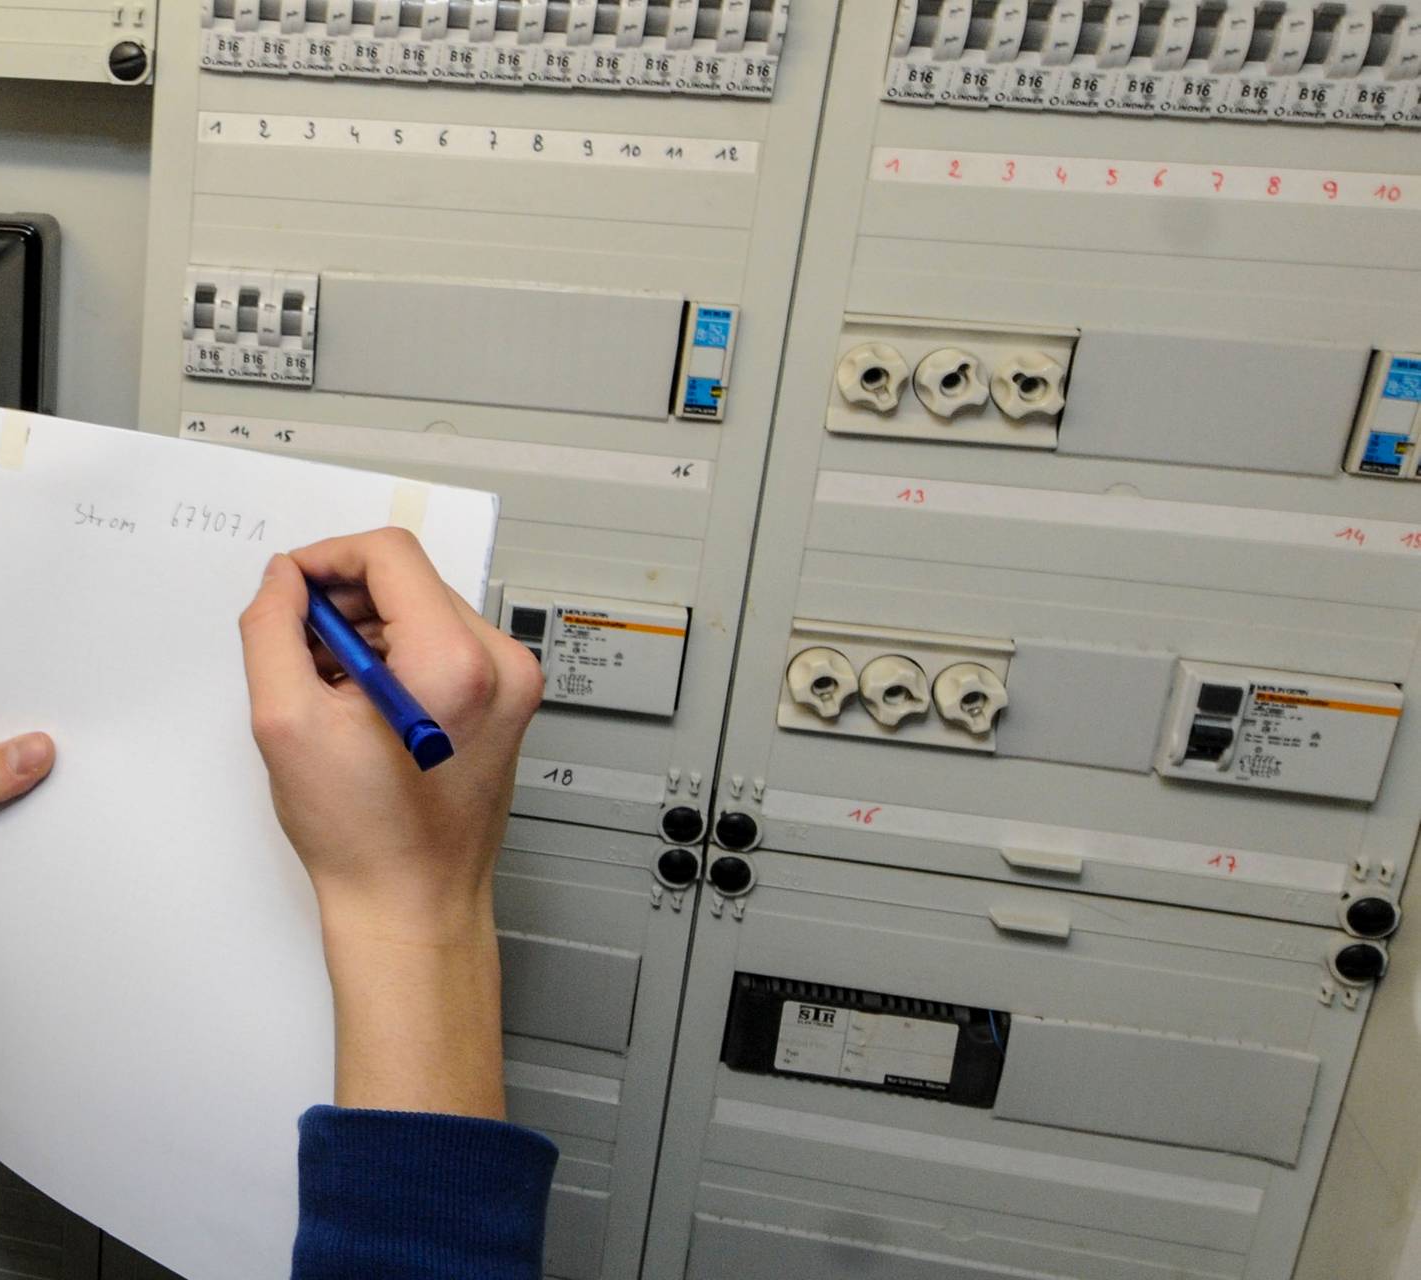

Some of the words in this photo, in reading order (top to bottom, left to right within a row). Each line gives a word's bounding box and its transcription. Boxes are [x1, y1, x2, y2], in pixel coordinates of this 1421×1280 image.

[209, 120, 222, 134] 1
[258, 120, 271, 138] 2
[304, 121, 316, 139] 3
[350, 125, 360, 143] 4
[394, 129, 403, 144] 5
[438, 130, 449, 147] 6
[489, 130, 498, 150] 7
[533, 134, 544, 152] 8
[583, 139, 594, 156] 9
[620, 144, 641, 157] 10
[666, 144, 683, 158] 11
[714, 147, 738, 161] 12
[885, 159, 899, 173] 1
[948, 159, 962, 178] 2
[1002, 160, 1015, 181] 3
[1056, 166, 1067, 184] 4
[1106, 168, 1118, 186] 5
[1153, 169, 1168, 187] 6
[1212, 171, 1223, 192] 7
[1267, 176, 1281, 195] 8
[1323, 180, 1338, 199] 9
[1374, 185, 1401, 201] 10
[230, 426, 250, 438] 14
[274, 430, 296, 442] 15
[671, 462, 694, 478] 16
[74, 503, 136, 534] Strom
[896, 488, 924, 503] 13
[1334, 528, 1365, 546] 14
[543, 768, 573, 786] 18
[848, 806, 881, 824] 16
[1207, 855, 1237, 873] 17
